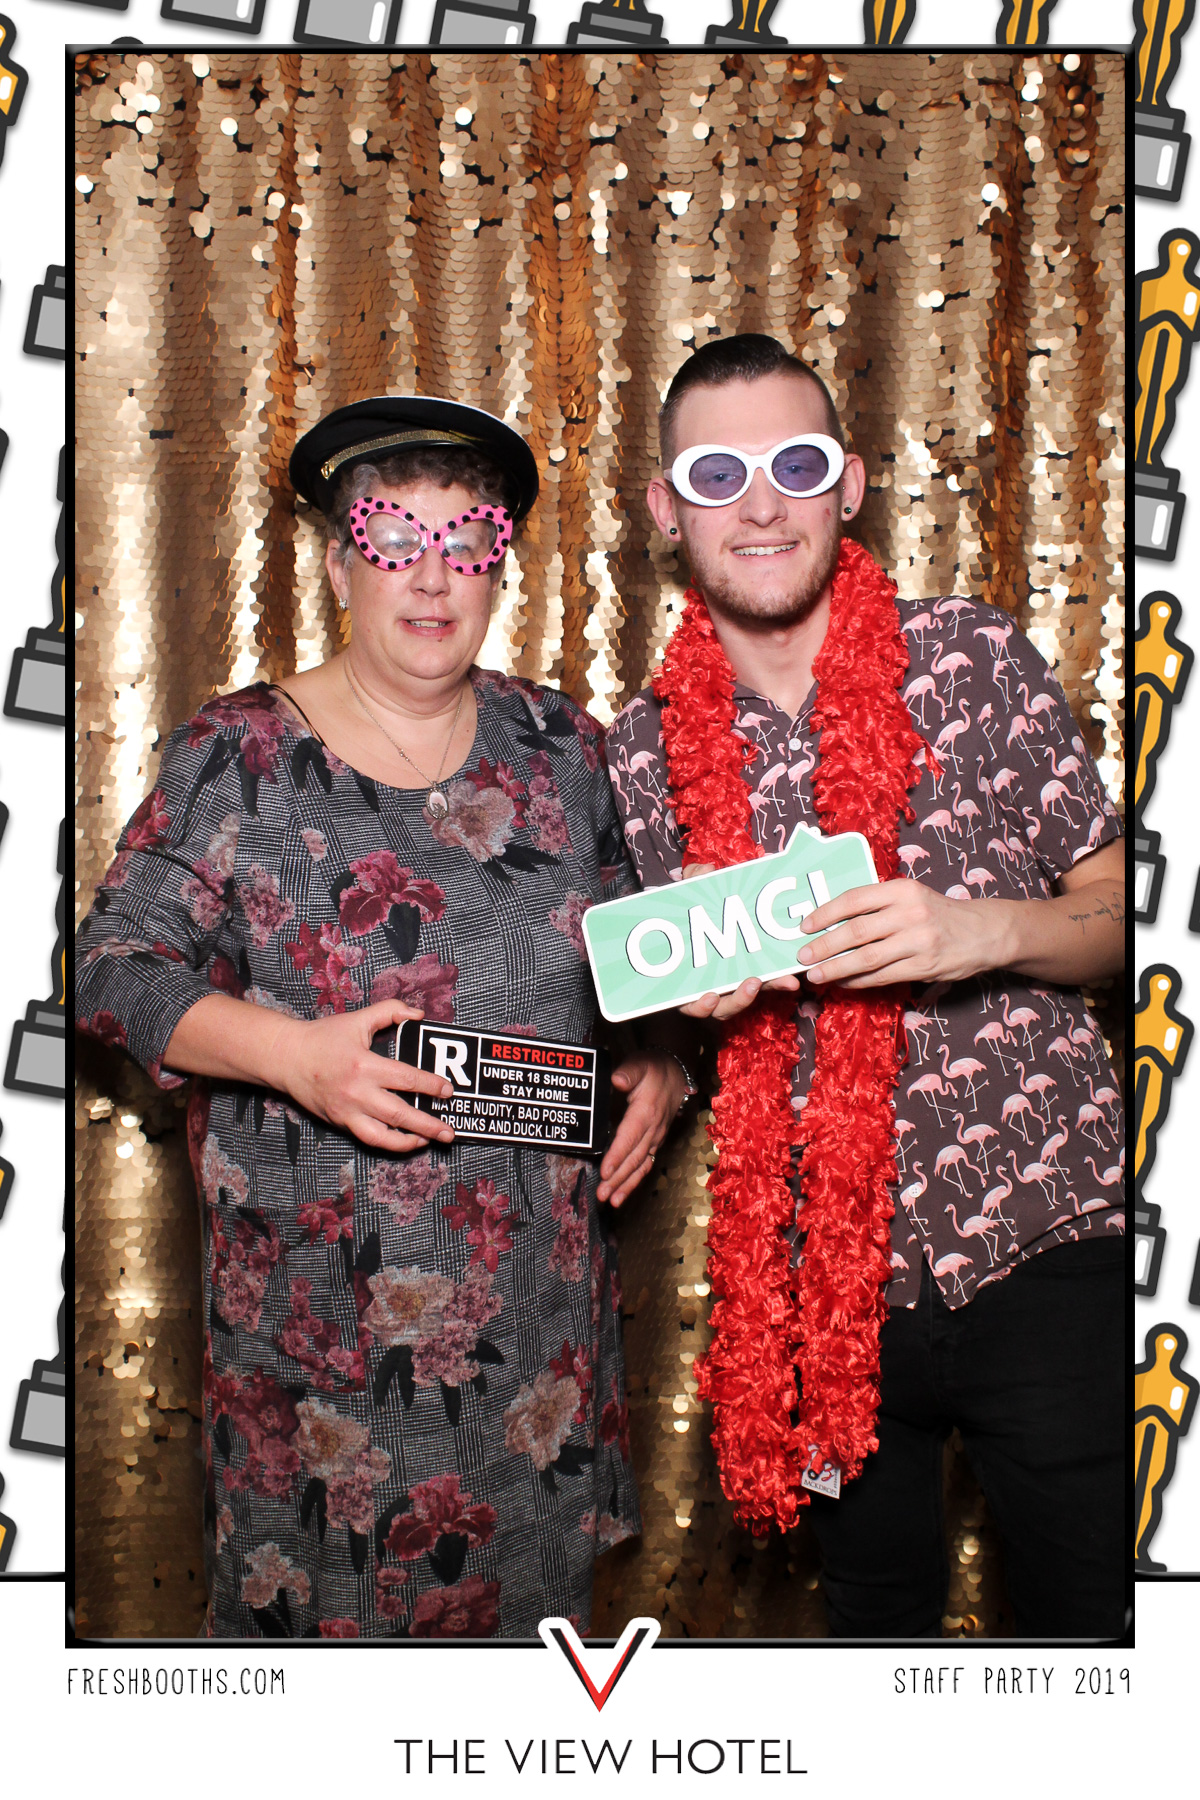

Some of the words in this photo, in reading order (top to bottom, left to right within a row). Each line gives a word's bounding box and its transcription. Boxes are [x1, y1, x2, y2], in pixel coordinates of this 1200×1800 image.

[429, 1037, 472, 1087] R
[491, 1043, 585, 1069] RESTRICTED
[483, 1065, 524, 1082] UNDER
[527, 1071, 541, 1084] 18
[543, 1074, 589, 1090] SHOULD
[502, 1084, 533, 1098] STAY
[536, 1088, 569, 1102] HOME
[432, 1097, 471, 1114] MAYBE
[473, 1101, 515, 1120] NUDITY,
[518, 1106, 540, 1121] BAD
[542, 1109, 579, 1127] POSES,
[441, 1114, 486, 1132] DRUNKS
[488, 1117, 511, 1134] AND
[513, 1121, 542, 1138] DUCK
[545, 1125, 568, 1140] LIPS
